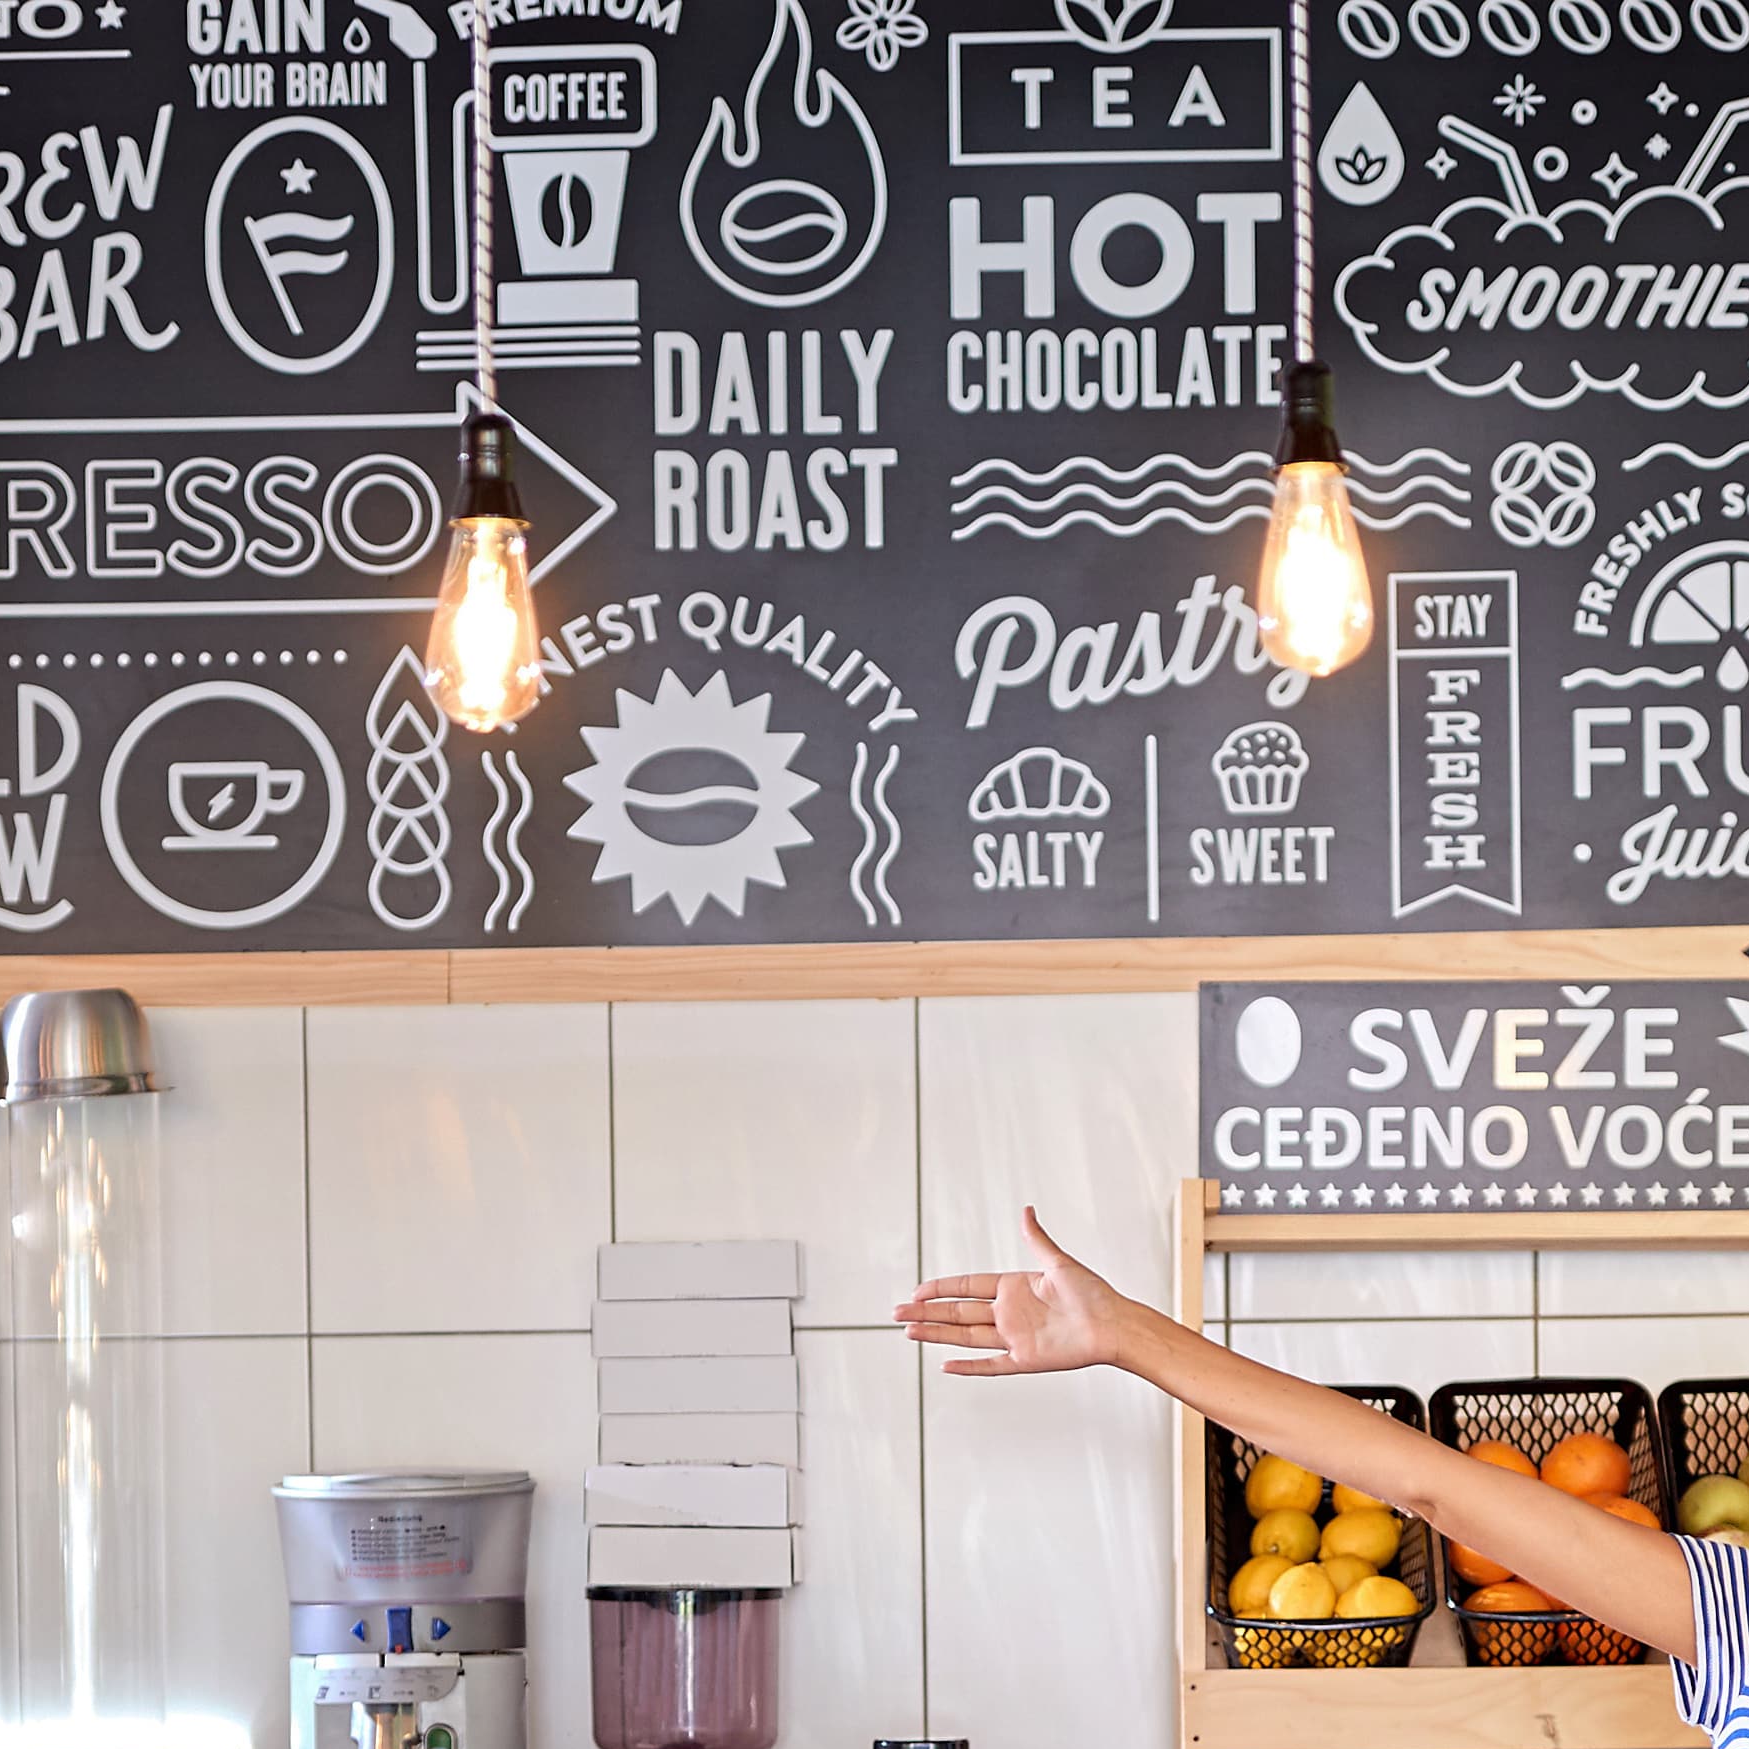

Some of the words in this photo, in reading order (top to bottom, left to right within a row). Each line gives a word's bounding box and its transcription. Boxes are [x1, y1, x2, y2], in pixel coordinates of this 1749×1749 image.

[187, 0, 325, 55] GAIN
[447, 0, 683, 40] PREMIUM
[190, 63, 274, 109] YOUR
[286, 61, 387, 107] BRAIN
[504, 71, 628, 123] COFFEE
[948, 191, 1283, 320] HOT
[654, 328, 896, 437] DAILY
[948, 324, 1287, 413] CHOCOLATE
[654, 447, 898, 552] ROAST
[1573, 485, 1703, 638] FRESHLY
[955, 573, 1313, 729] Pastr
[1414, 593, 1492, 640] STAY
[678, 590, 919, 733] QUALITY
[1423, 668, 1487, 870] FRESH
[972, 830, 1107, 892] SALTY
[1189, 826, 1336, 888] SWEET
[1348, 984, 1681, 1091] SVEŽE
[1213, 1104, 1530, 1171] CEĐENO
